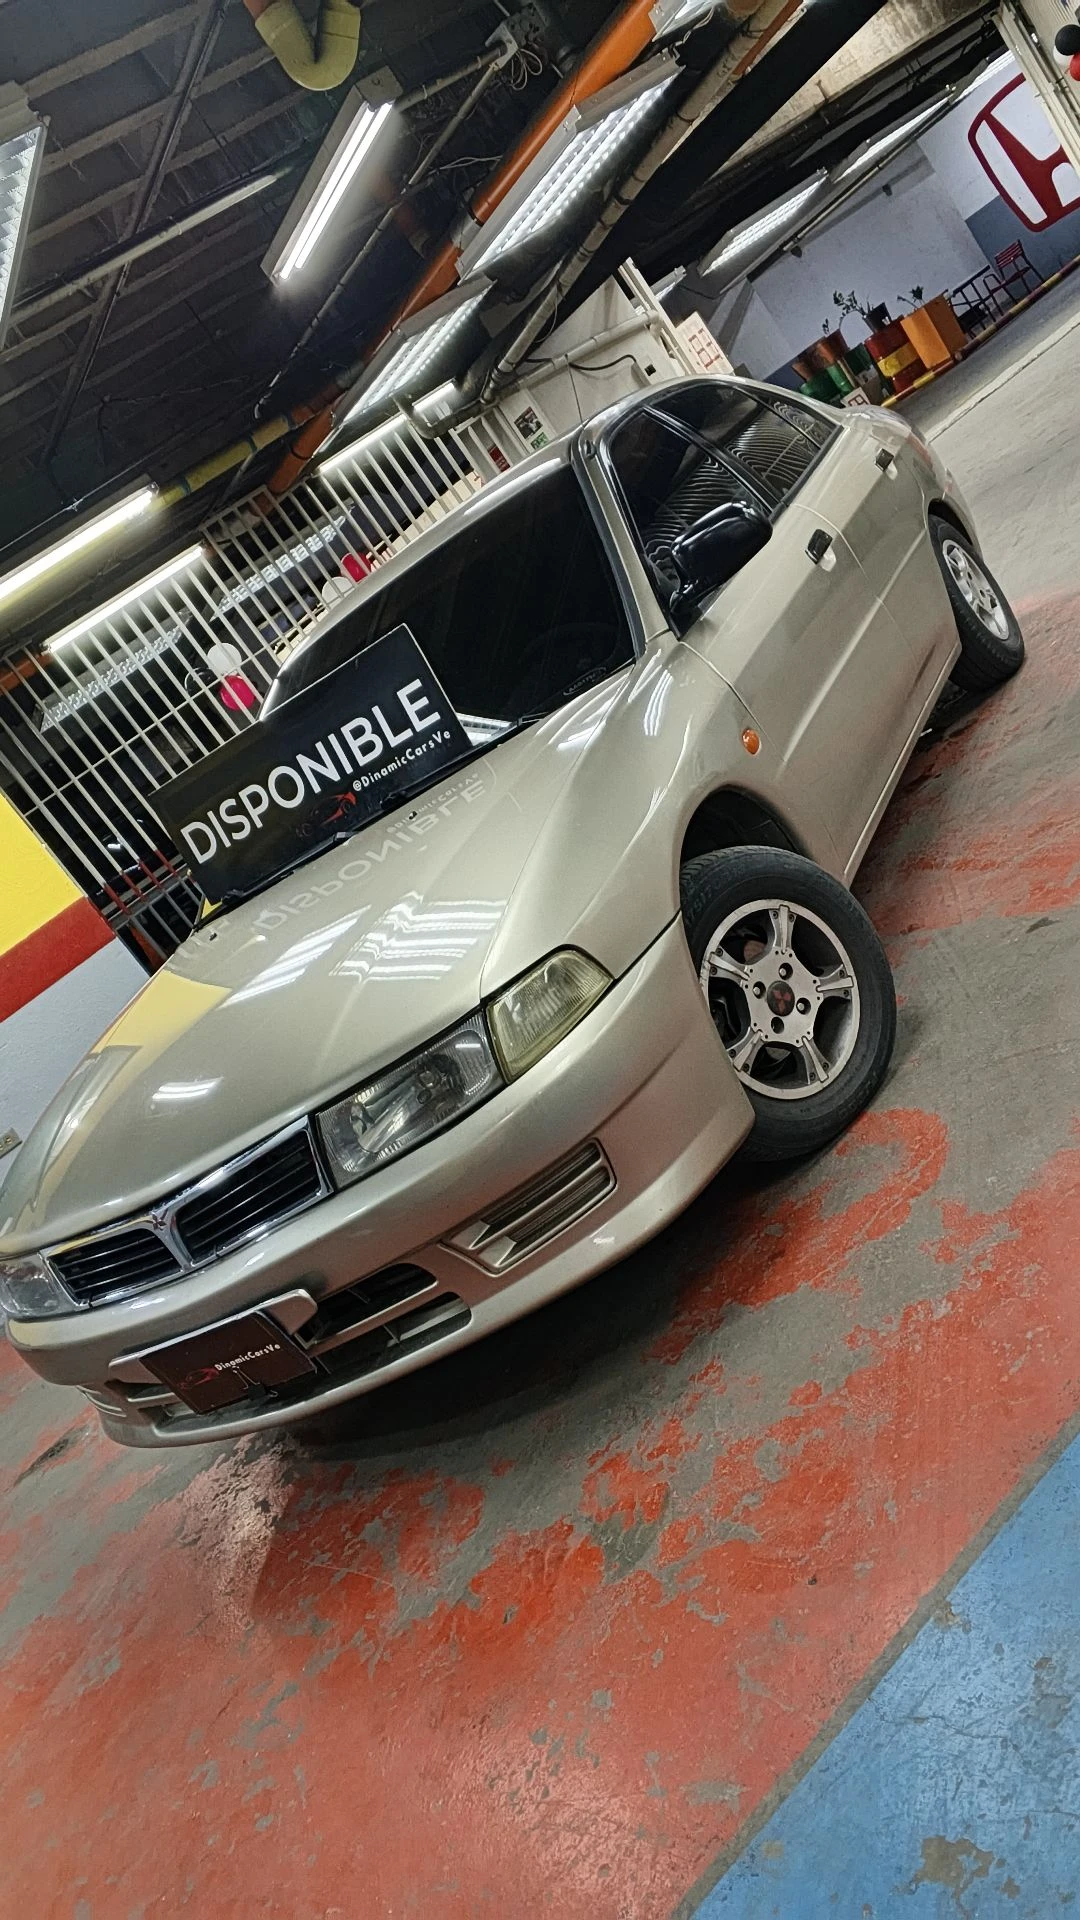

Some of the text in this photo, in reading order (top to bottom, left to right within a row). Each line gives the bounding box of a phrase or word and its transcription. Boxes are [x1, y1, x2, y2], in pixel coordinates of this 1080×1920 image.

[180, 678, 441, 864] DISPONIBLE
[353, 730, 451, 791] @DinamicCarsVe
[214, 1343, 281, 1371] DinamicCarsVe
